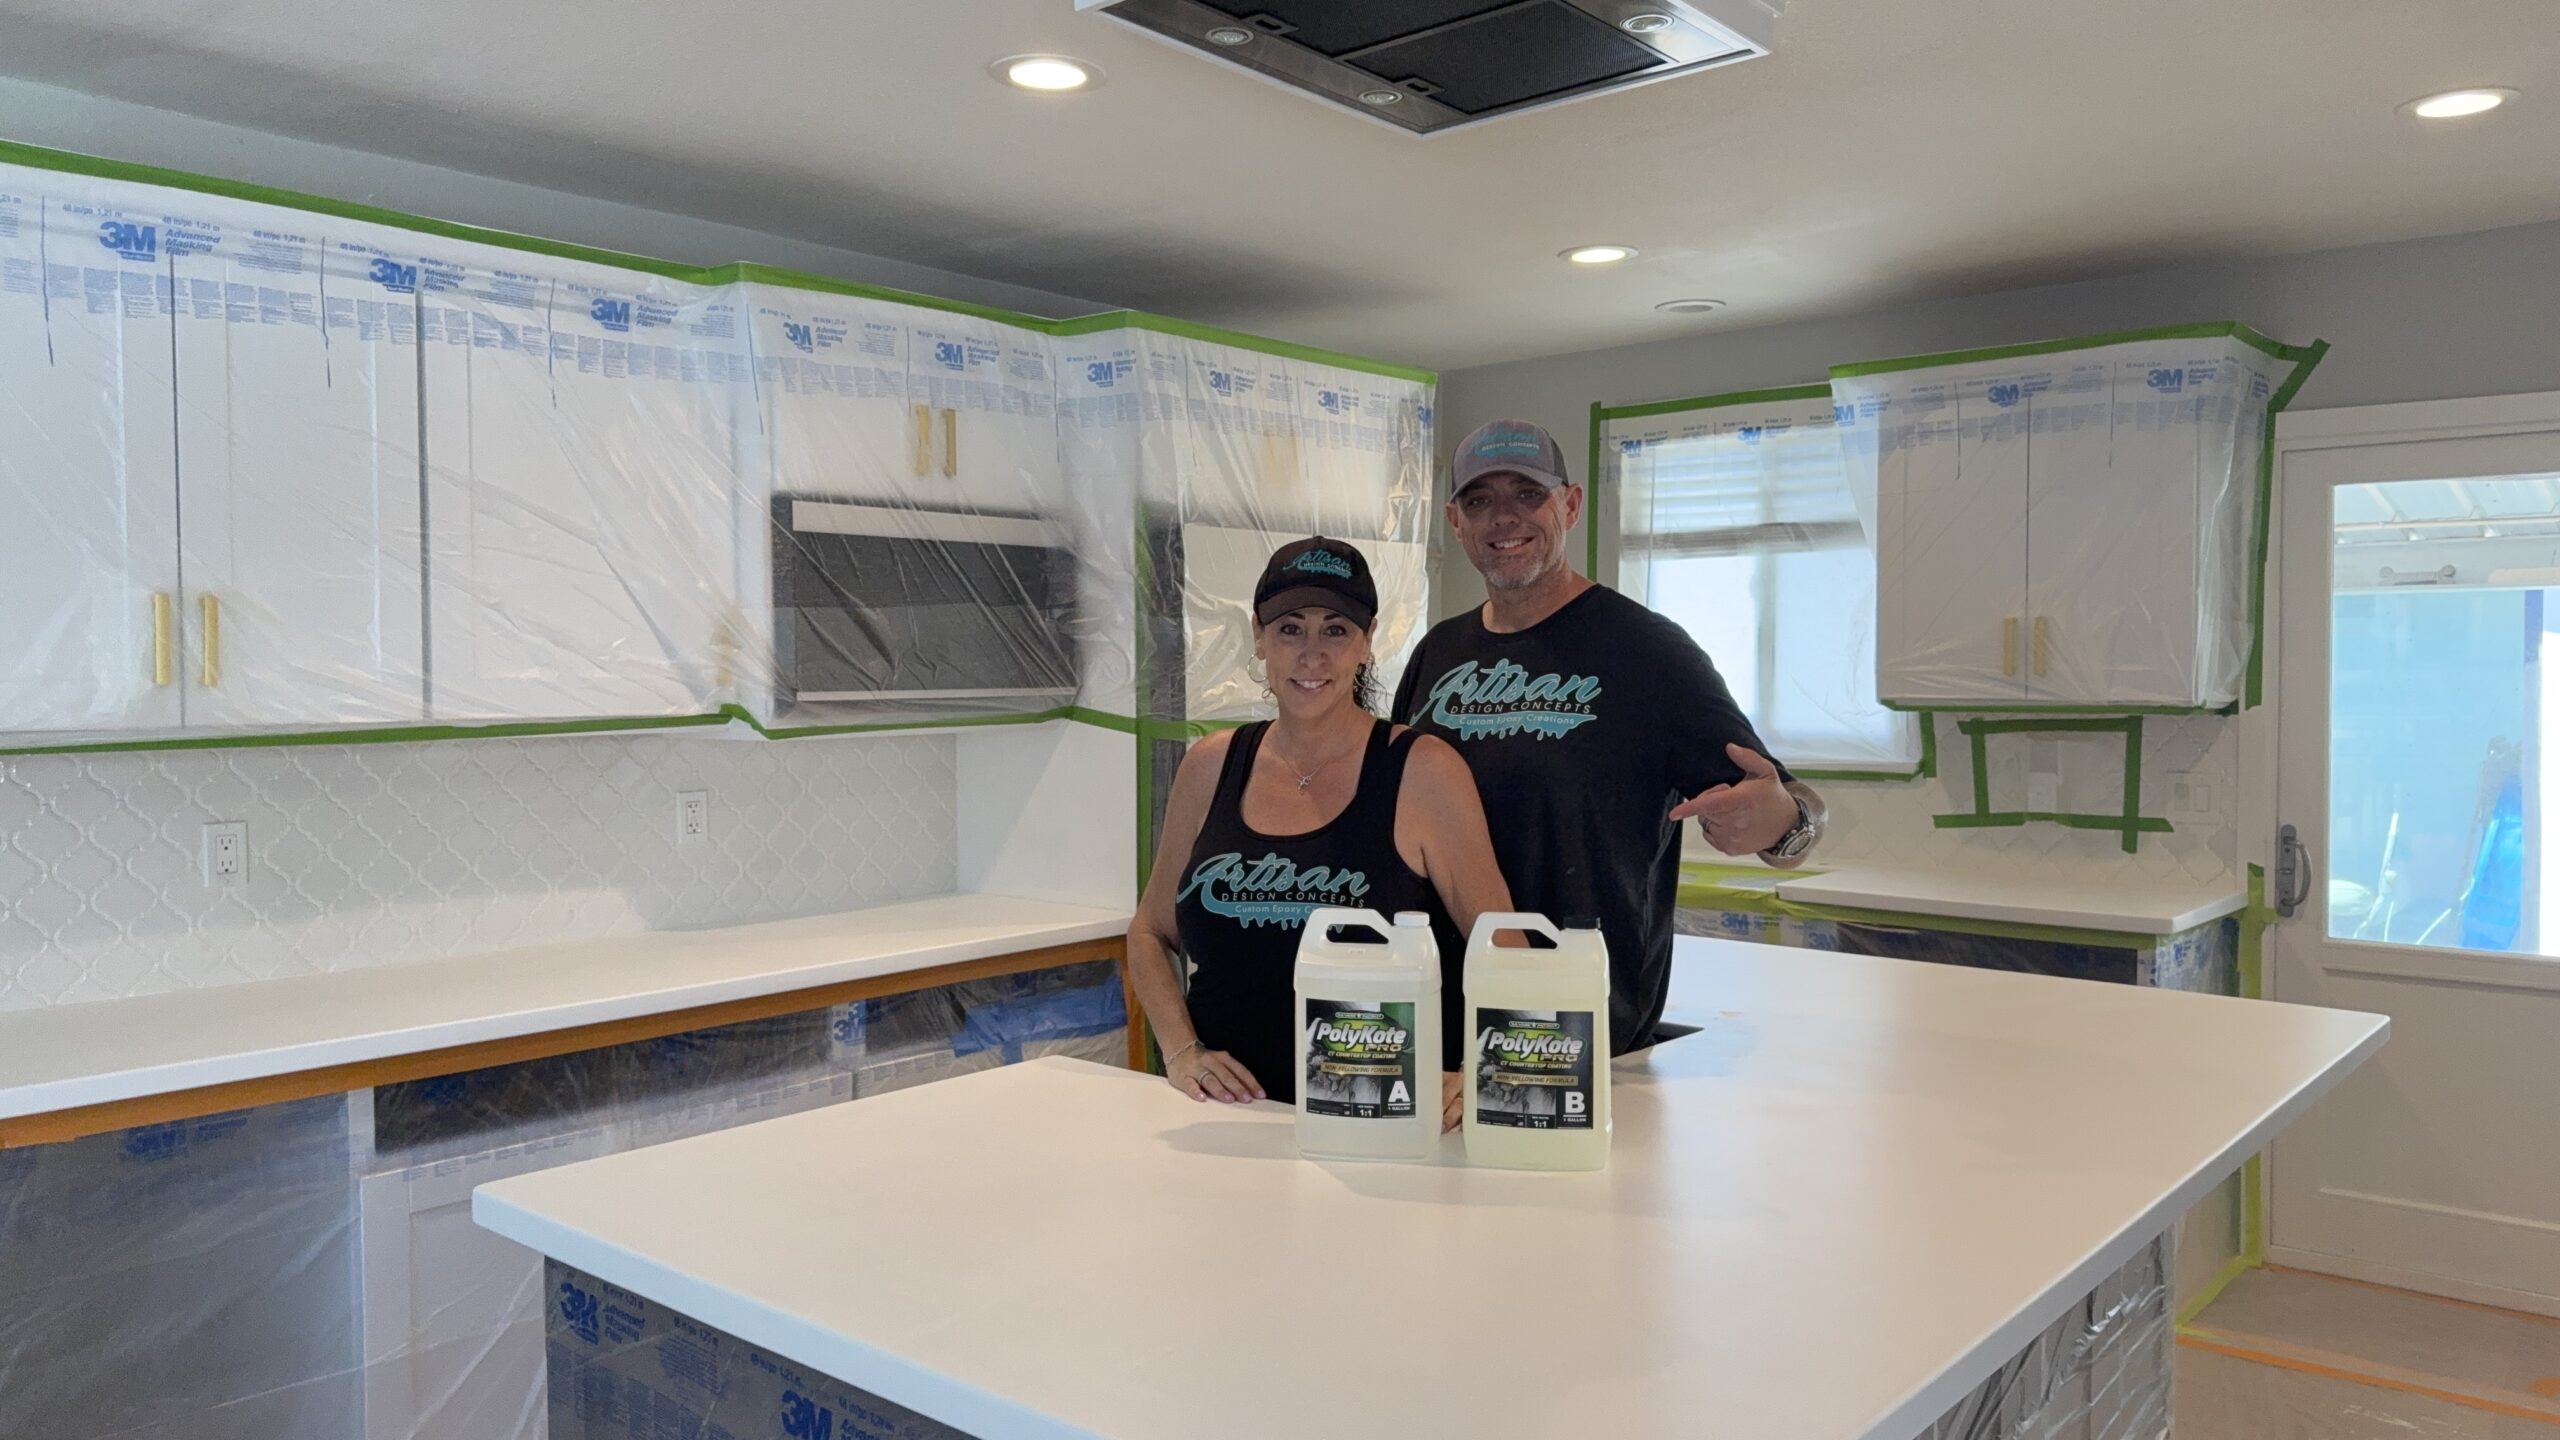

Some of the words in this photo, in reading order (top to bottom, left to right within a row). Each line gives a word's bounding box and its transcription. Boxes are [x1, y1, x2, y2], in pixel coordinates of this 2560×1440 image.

[99, 221, 156, 252] 3M
[165, 229, 221, 244] Advanced
[165, 239, 213, 253] Masking
[165, 247, 190, 257] Film
[369, 258, 417, 287] 3M
[590, 298, 631, 325] 3M
[636, 304, 680, 317] Advanced
[636, 312, 673, 325] Masking
[636, 319, 655, 329] Film
[783, 322, 813, 346] 3M
[935, 341, 964, 364] 3M
[1087, 361, 1113, 382] 3M
[1209, 369, 1232, 391] 3M
[2147, 368, 2183, 388] 3M
[1318, 390, 1339, 409] 3M
[1987, 383, 2019, 403] 3M
[1620, 440, 1642, 454] 3M
[1409, 658, 1602, 726] Artisan
[1450, 704, 1504, 714] DESIGN
[1510, 701, 1592, 714] CONCEPTS
[1459, 716, 1494, 725] Custom
[1526, 713, 1576, 725] Creations
[1176, 852, 1370, 904] Artisan
[1221, 892, 1276, 902] DESIGN
[1285, 891, 1365, 908] CONCEPTS
[1235, 904, 1270, 914] Custom
[1272, 904, 1301, 916] Epoxy
[1721, 911, 1750, 930] 3M
[1316, 1022, 1407, 1050] PolyKote
[1487, 1031, 1583, 1060] PolyKote
[1335, 1051, 1372, 1059] COUNTERTOP
[1364, 1043, 1403, 1052] PRO
[1508, 1061, 1546, 1069] COUNTERTOP
[1540, 1053, 1578, 1062] PRO
[1387, 1080, 1411, 1103] A
[1565, 1091, 1585, 1113] B
[1359, 1109, 1373, 1117] 1:1
[1533, 1120, 1548, 1128] 1:1
[781, 1390, 832, 1440] 3M
